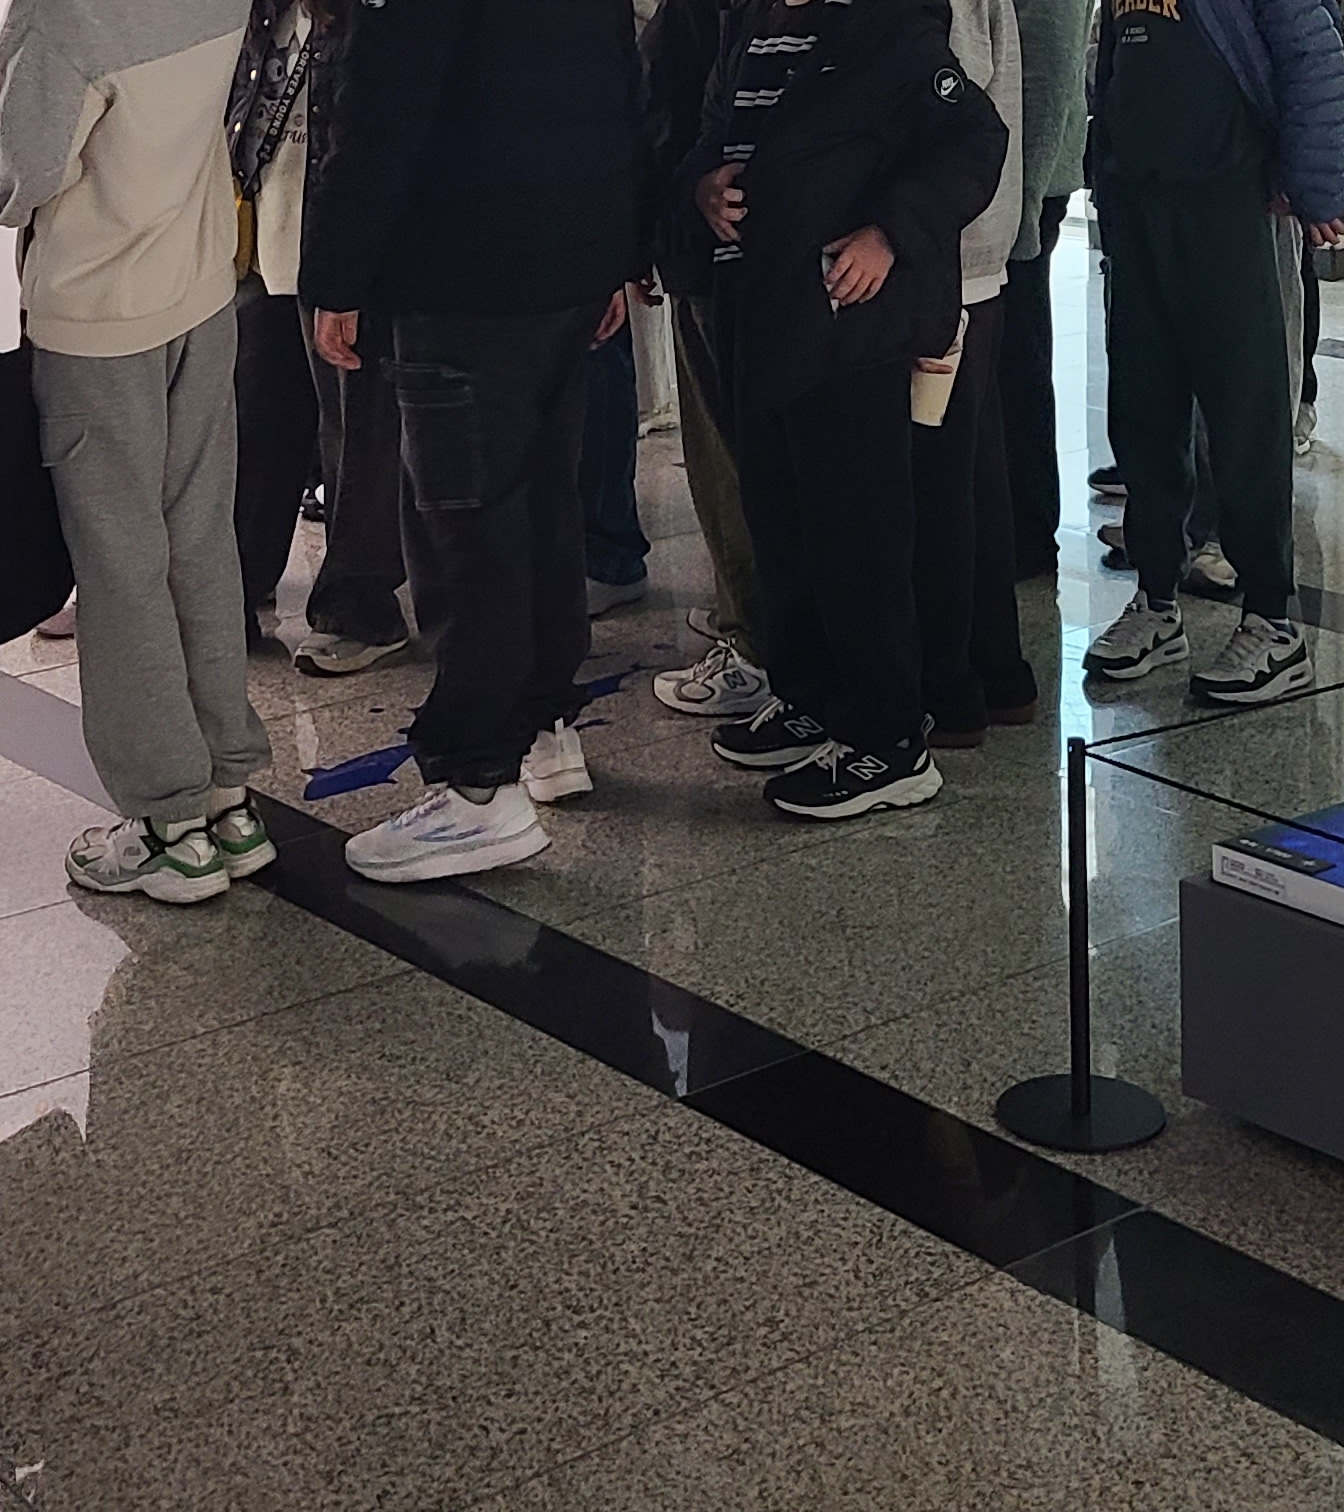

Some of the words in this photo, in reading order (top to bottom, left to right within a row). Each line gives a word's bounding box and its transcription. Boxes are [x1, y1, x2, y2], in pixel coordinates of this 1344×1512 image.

[269, 99, 291, 136] YOUNG
[723, 670, 747, 689] N
[783, 715, 824, 739] N
[846, 754, 889, 781] N
